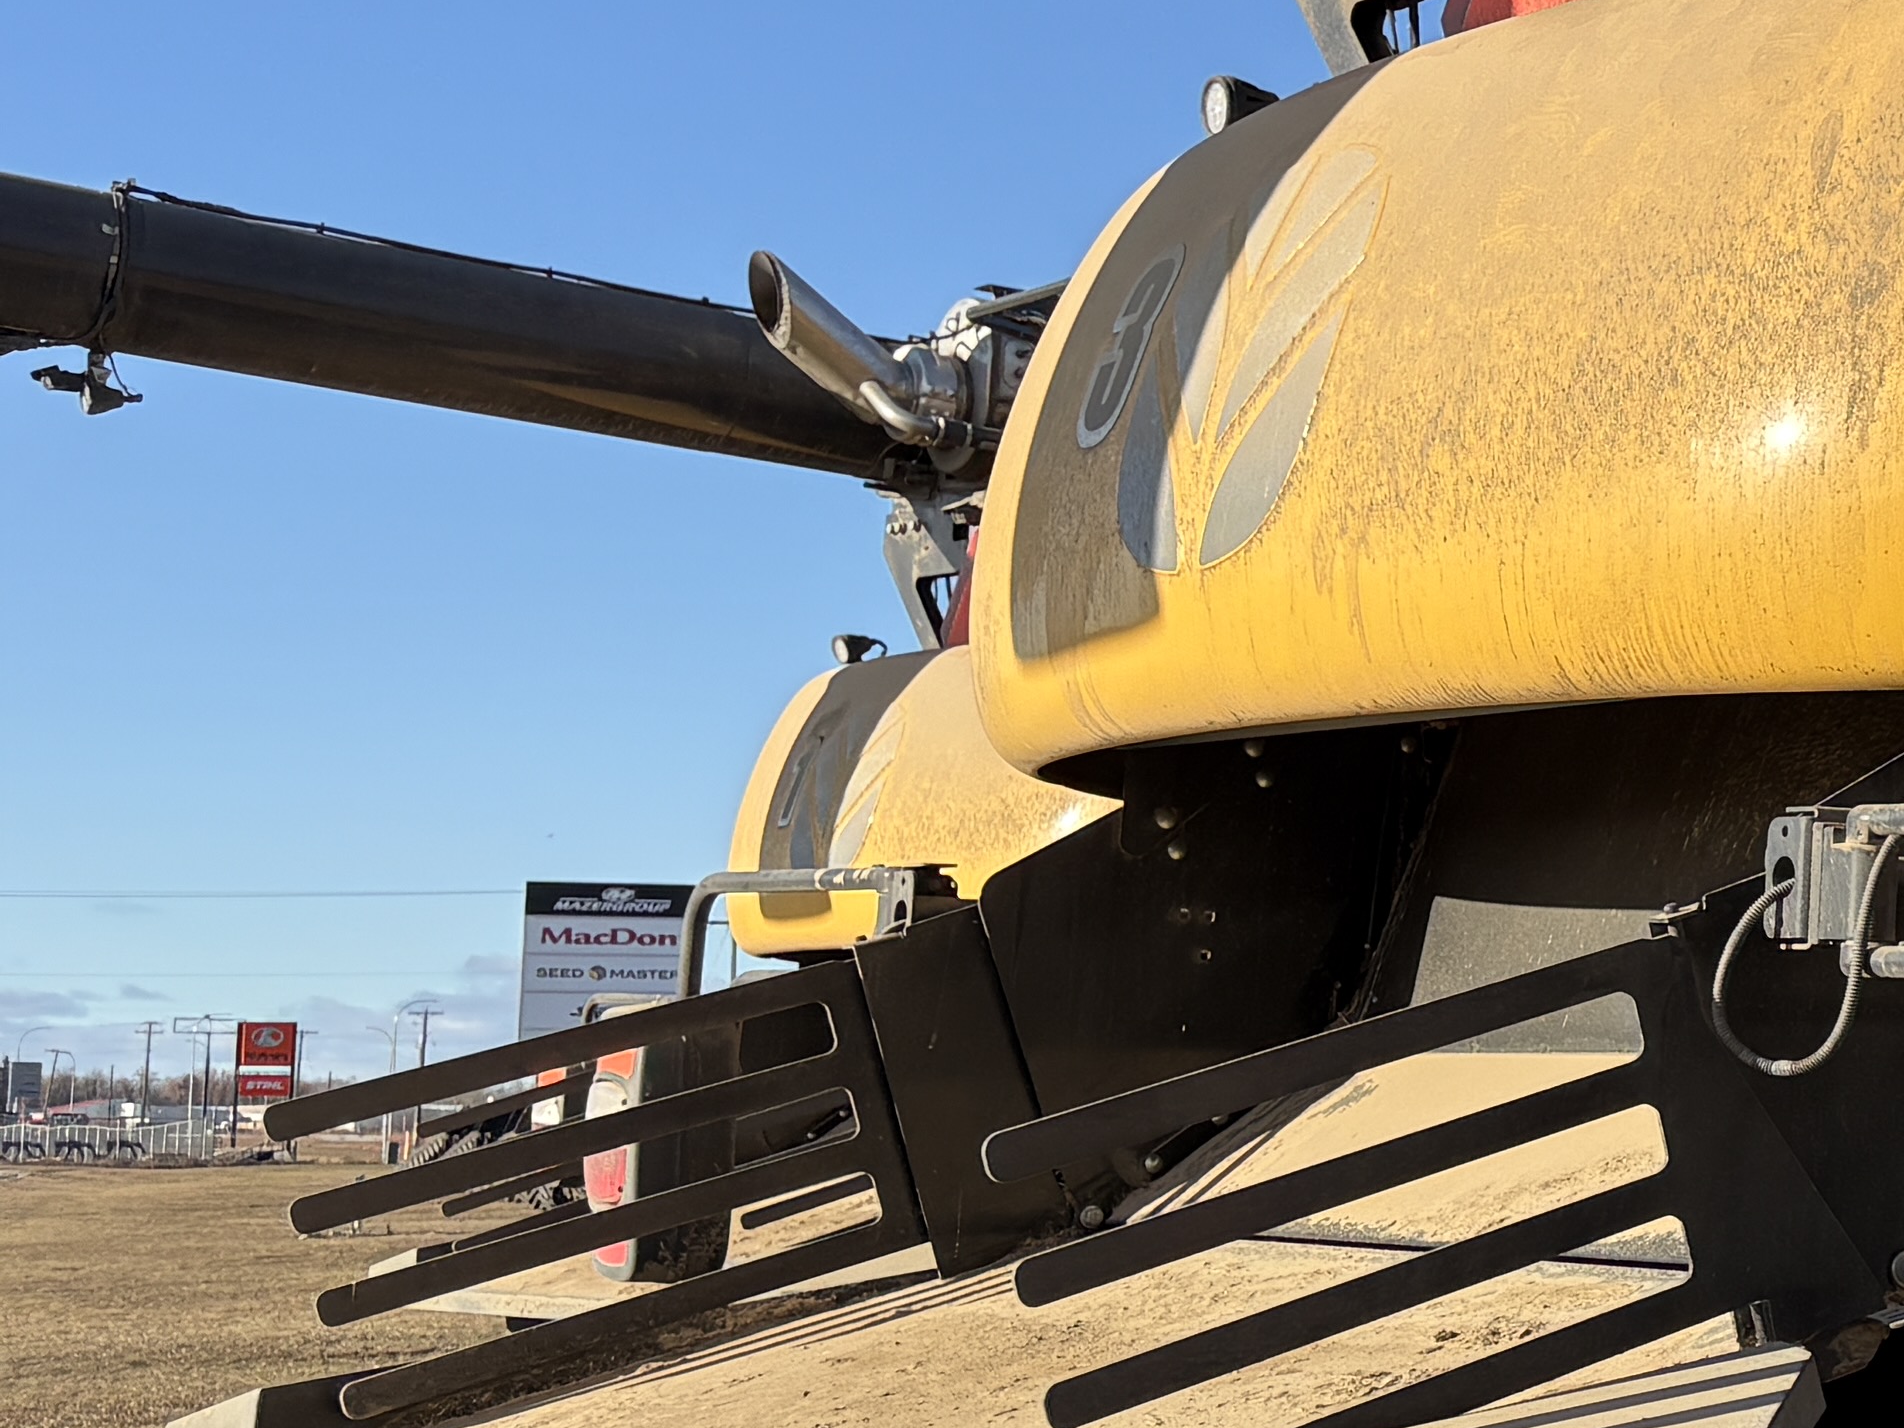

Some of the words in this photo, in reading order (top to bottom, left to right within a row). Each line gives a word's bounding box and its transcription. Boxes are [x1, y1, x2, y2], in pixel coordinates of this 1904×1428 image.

[1075, 243, 1186, 450] 3
[553, 898, 672, 914] MAZERGROUP
[541, 926, 677, 946] MacDon
[536, 967, 584, 979] SEED
